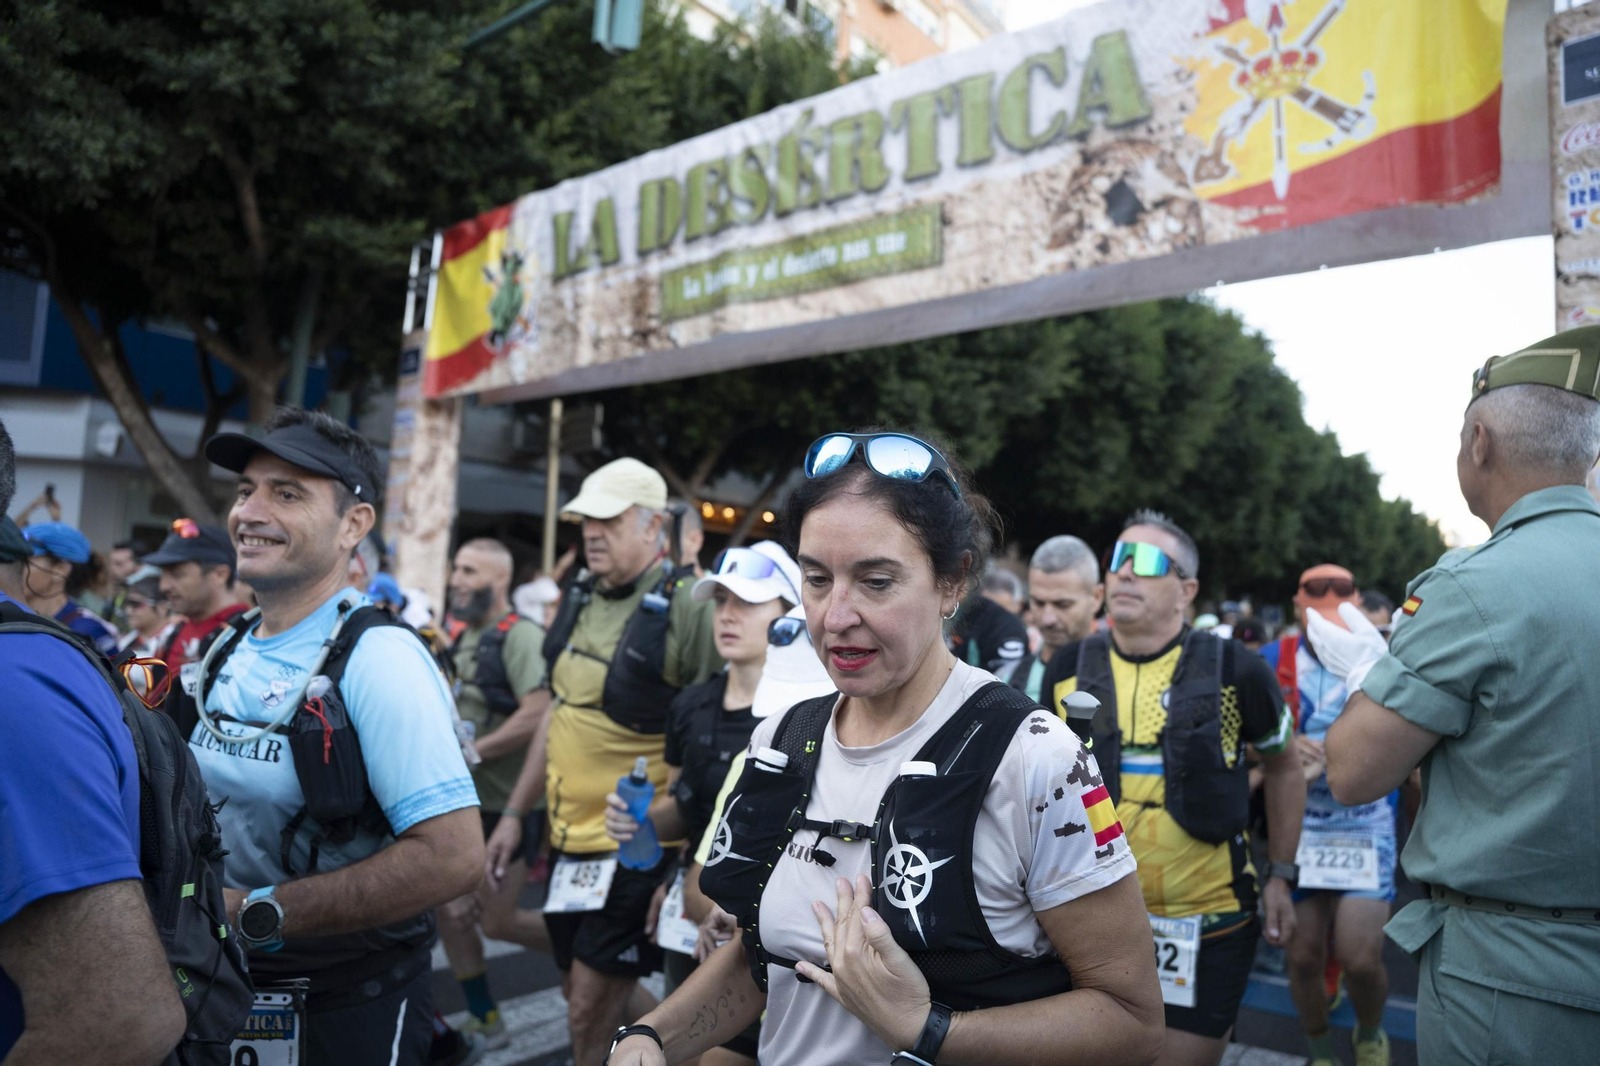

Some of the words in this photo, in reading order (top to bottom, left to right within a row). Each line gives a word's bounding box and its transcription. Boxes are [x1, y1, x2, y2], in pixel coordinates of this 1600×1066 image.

[552, 197, 620, 284] LA
[636, 29, 1153, 256] DESÉRTICA
[1314, 849, 1365, 870] 2229
